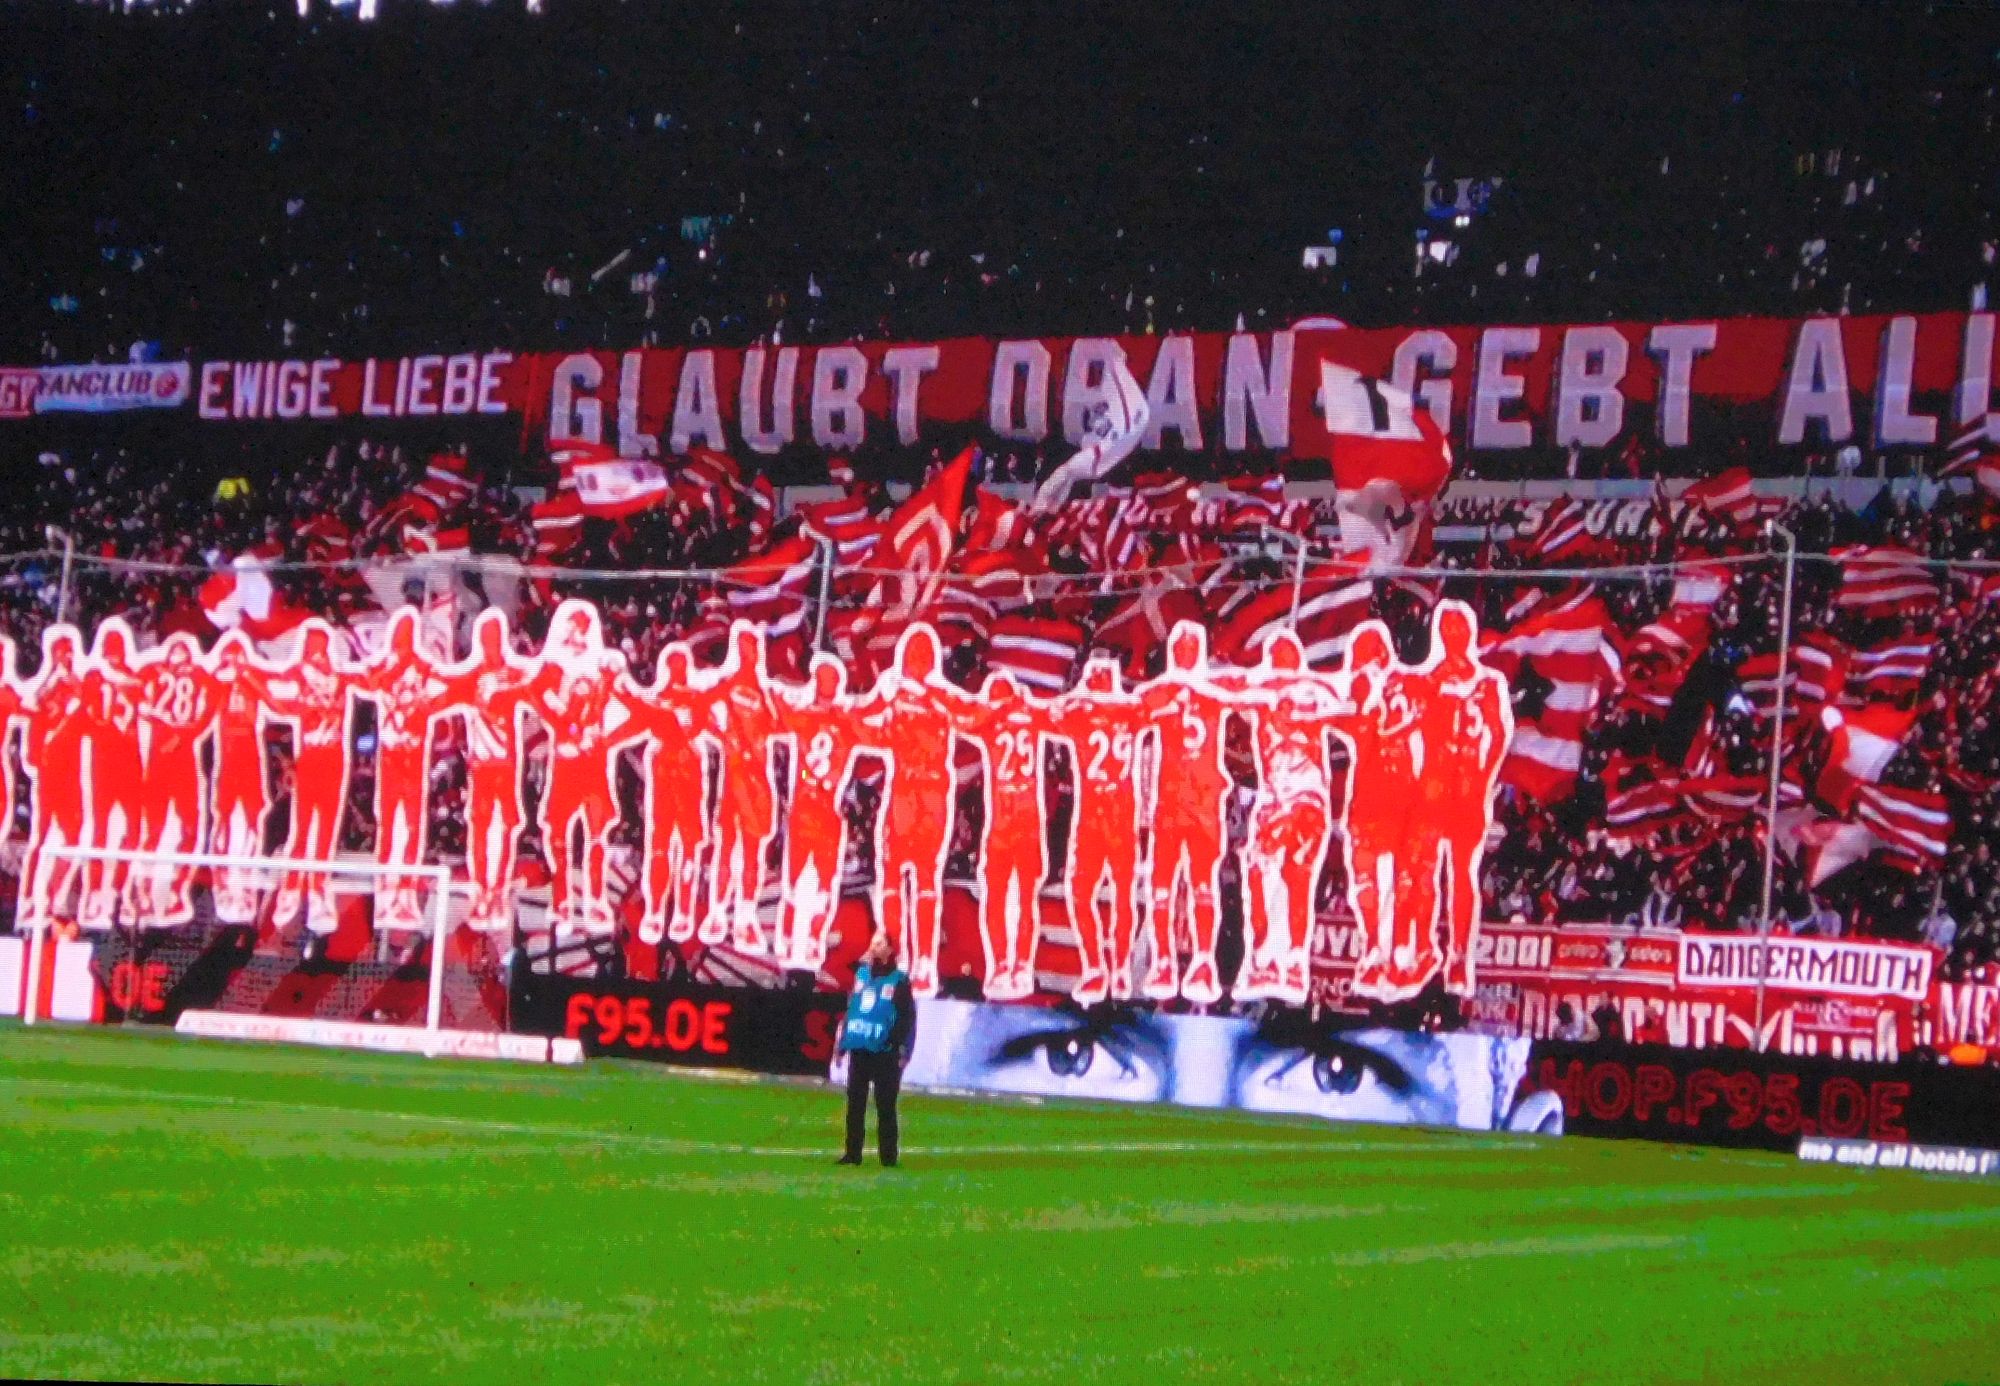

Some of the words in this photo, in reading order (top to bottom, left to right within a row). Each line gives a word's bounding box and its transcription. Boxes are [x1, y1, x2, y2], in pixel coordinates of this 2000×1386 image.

[199, 358, 340, 418] EWIGE
[362, 352, 513, 415] LIEBE
[549, 344, 939, 455] GLAUBT
[1391, 325, 1717, 447] GEBT
[155, 672, 195, 725] 28
[805, 731, 833, 778] 8
[1836, 1141, 1878, 1166] and
[1879, 1144, 1908, 1167] all
[1910, 1146, 1977, 1174] hotels
